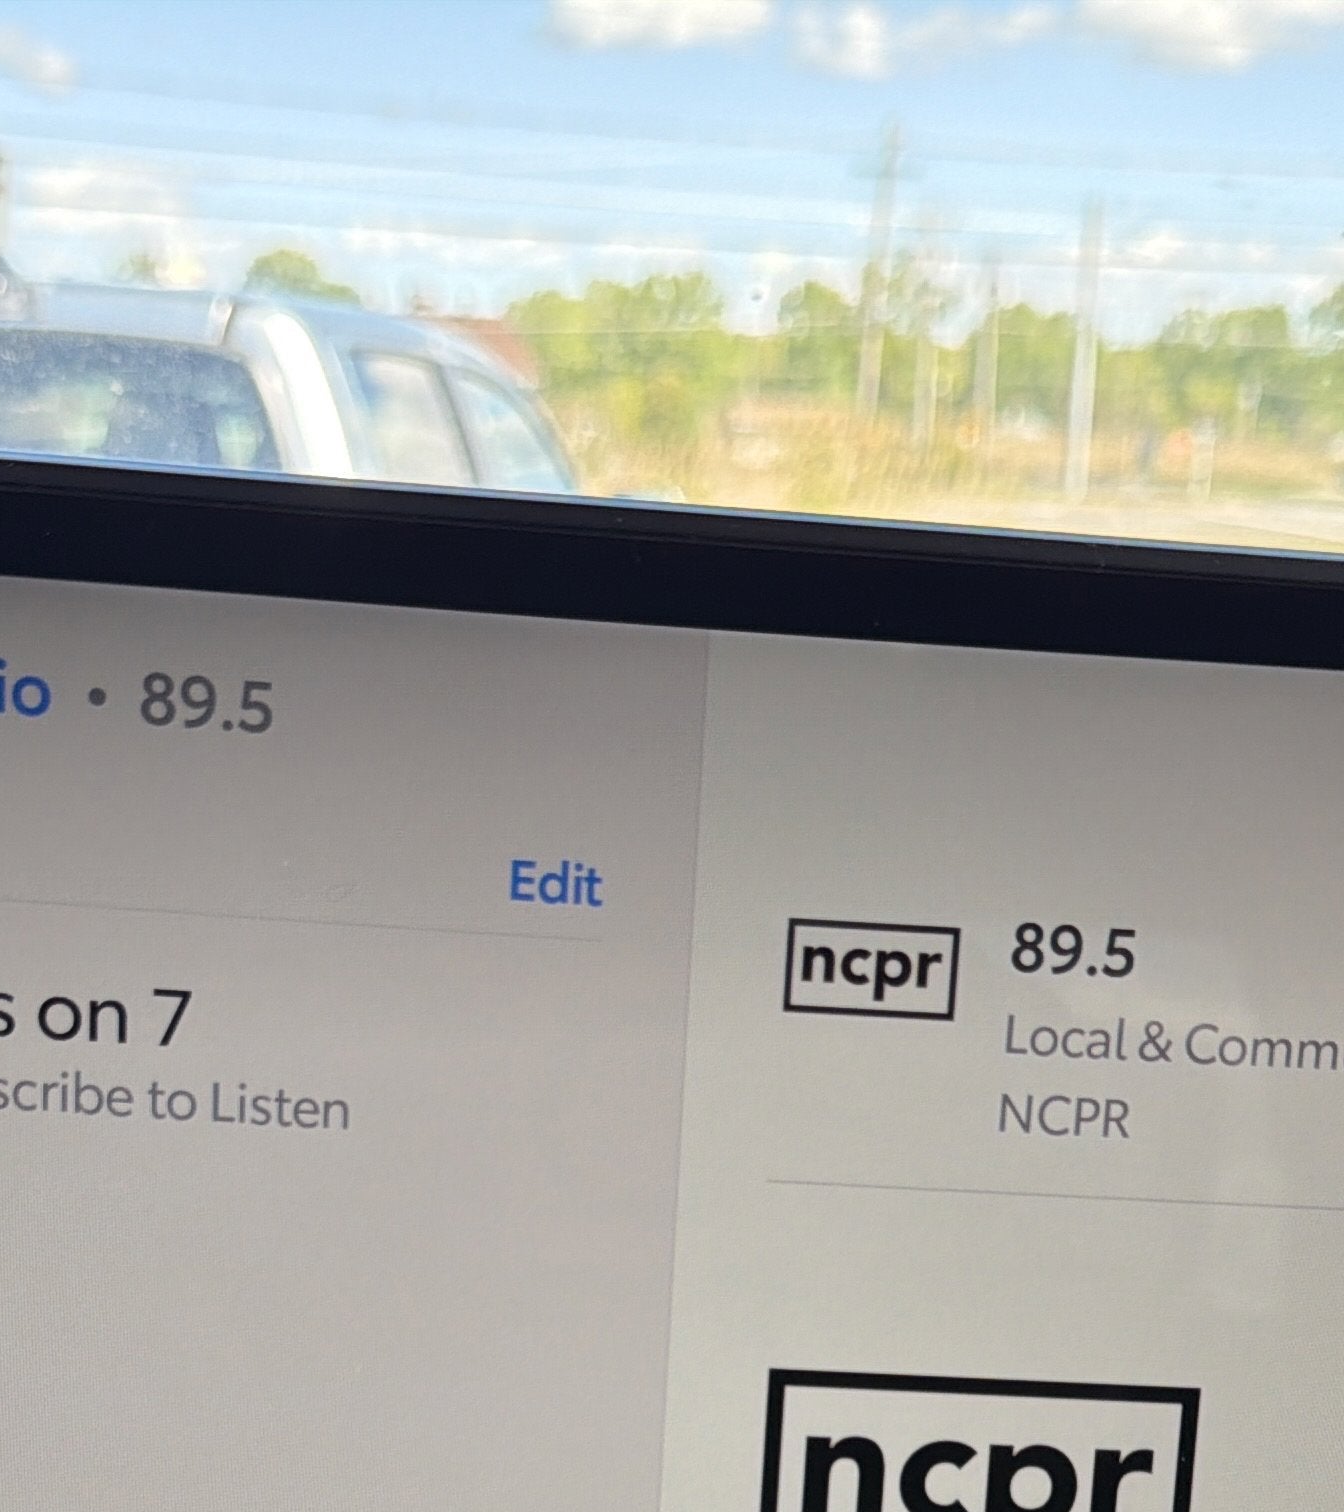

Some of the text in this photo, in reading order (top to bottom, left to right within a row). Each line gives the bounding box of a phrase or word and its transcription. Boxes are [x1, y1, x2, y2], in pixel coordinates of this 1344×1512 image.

[141, 672, 272, 733] 89.5
[511, 860, 602, 907] Edit
[801, 945, 943, 1002] ncpr
[1012, 923, 1135, 977] 89.5
[38, 997, 127, 1043] on
[154, 989, 191, 1046] 7
[1006, 1015, 1127, 1061] Local
[1138, 1021, 1172, 1062] &
[148, 1082, 196, 1121] to
[212, 1082, 348, 1129] Listen
[999, 1094, 1129, 1138] NCPR
